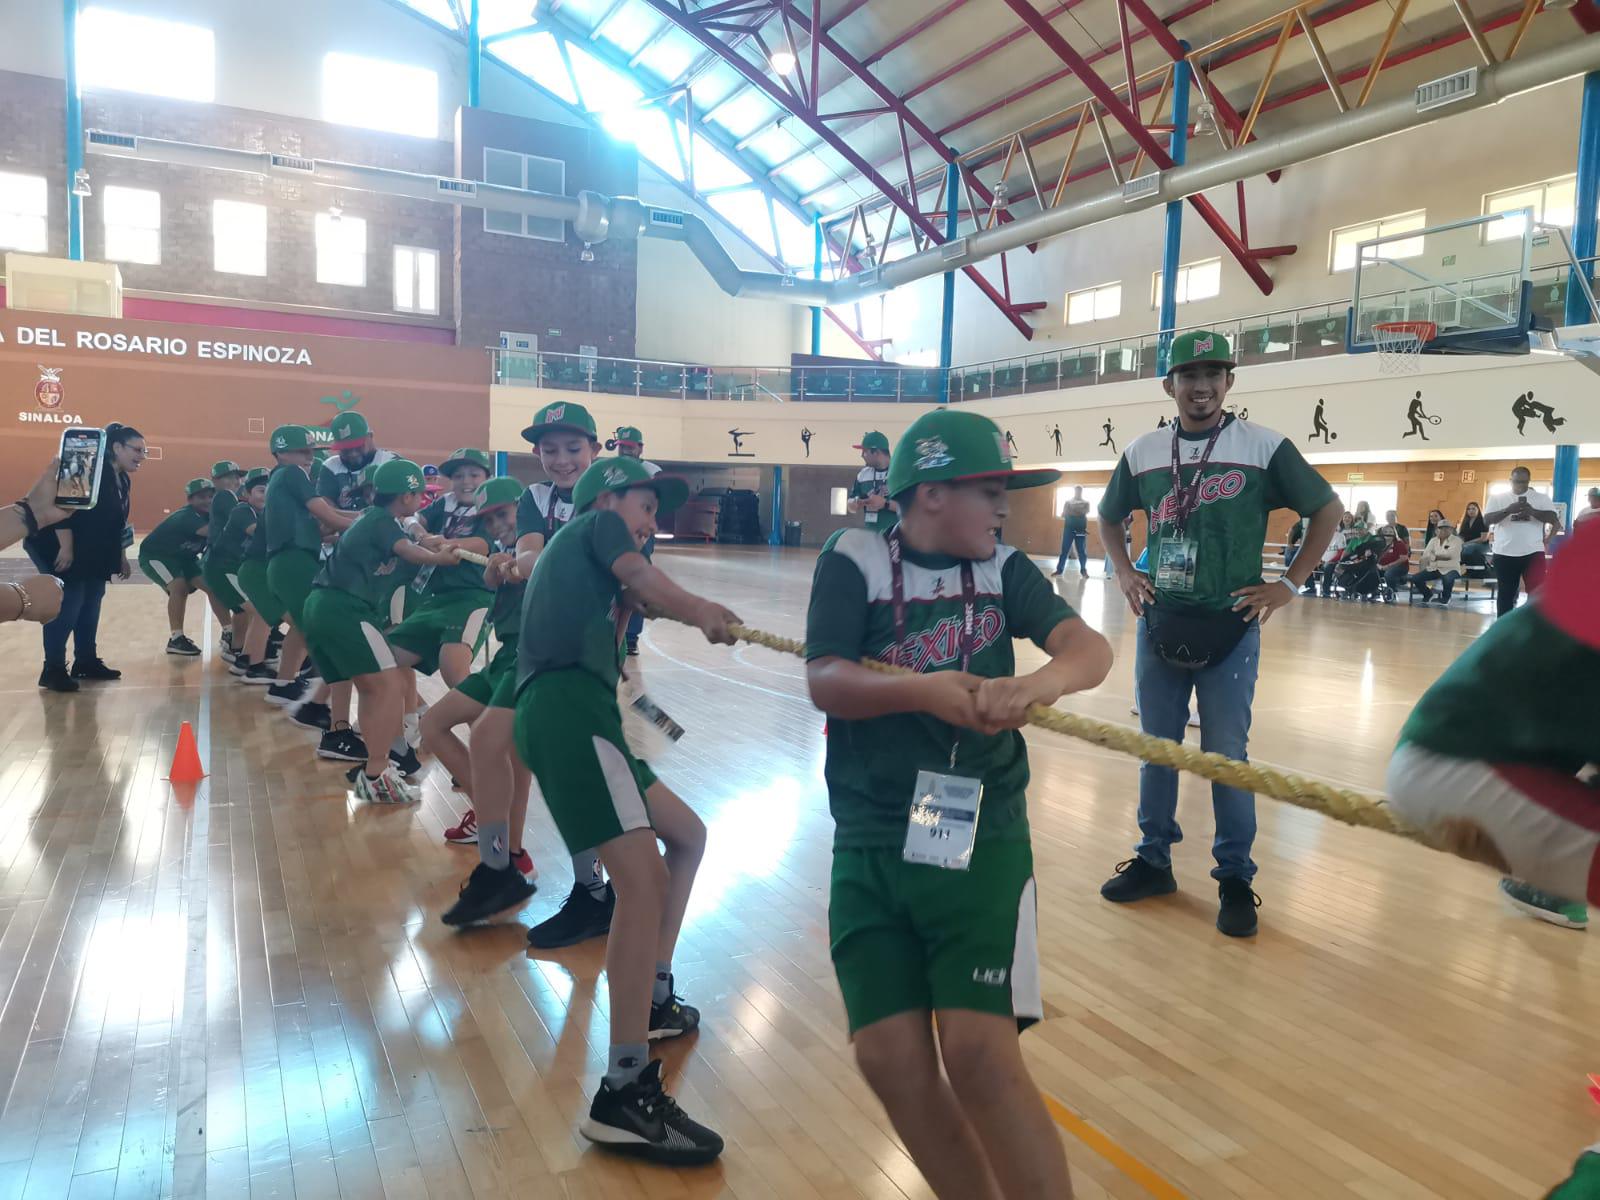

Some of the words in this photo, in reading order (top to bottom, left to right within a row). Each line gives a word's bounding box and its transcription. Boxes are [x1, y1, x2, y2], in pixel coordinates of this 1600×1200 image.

[17, 326, 66, 347] DEL
[76, 331, 187, 355] ROSARIO
[198, 340, 312, 365] ESPINOZA
[18, 411, 83, 425] SINALOA
